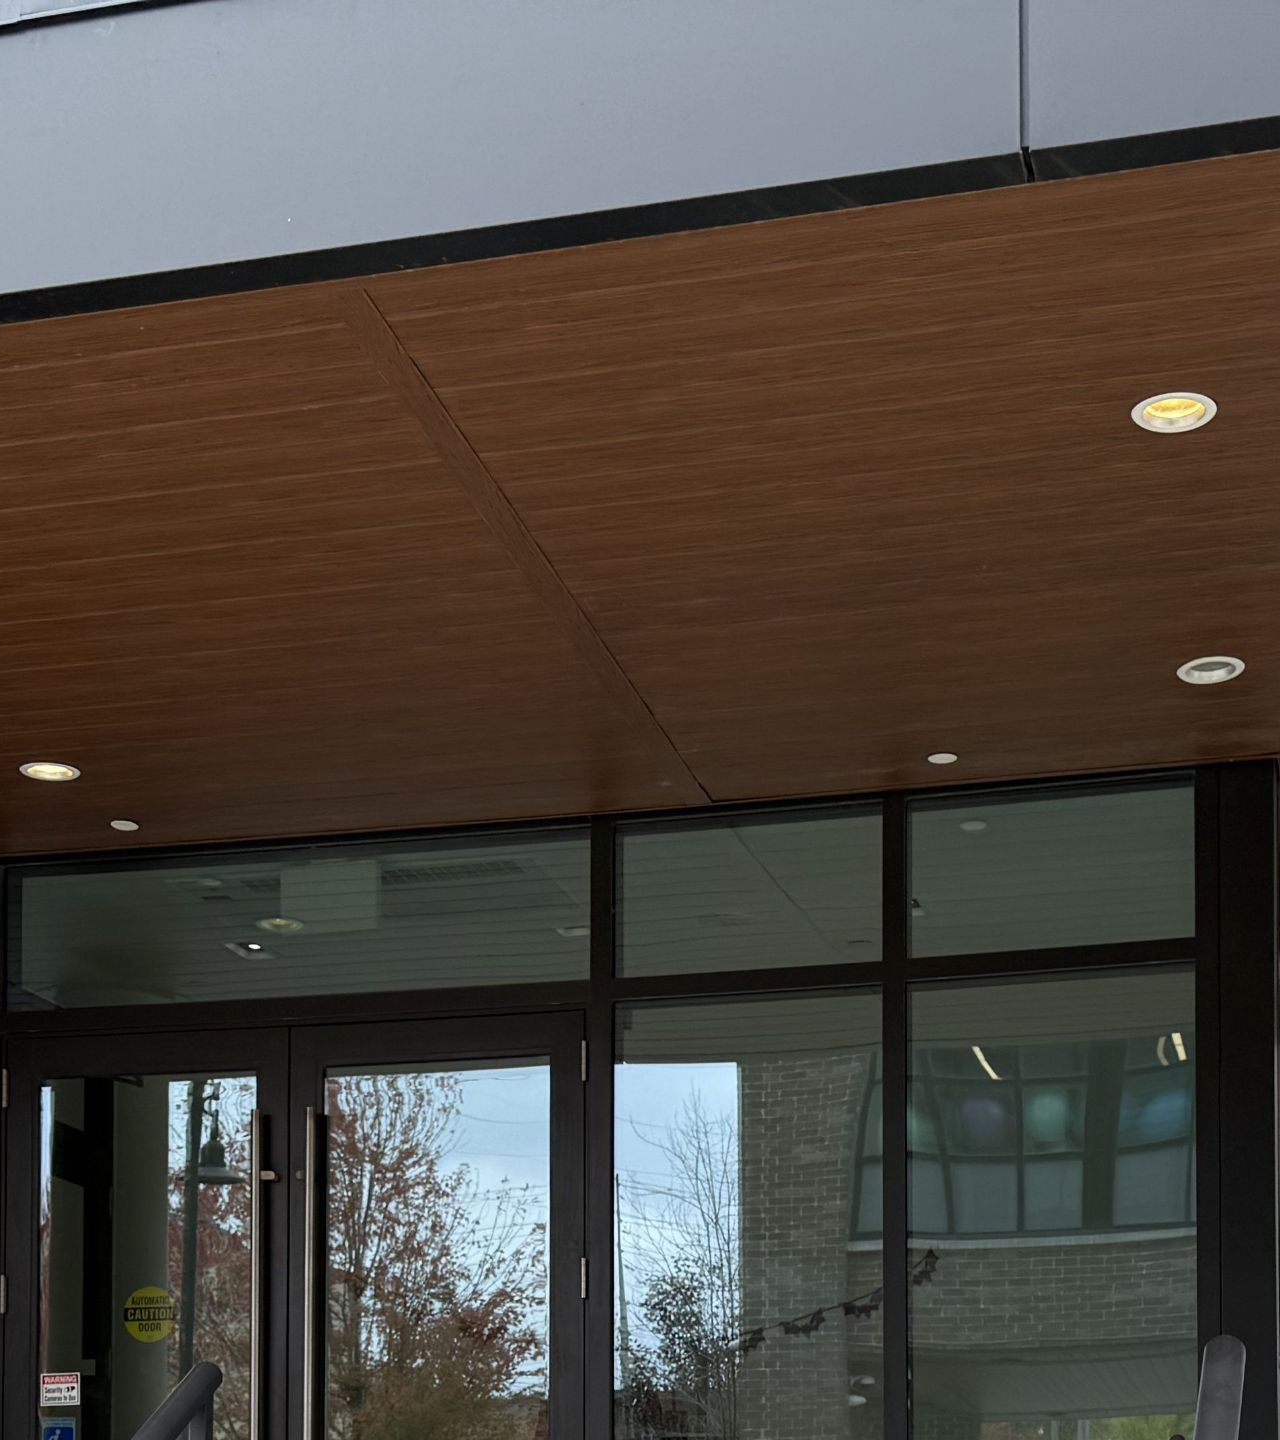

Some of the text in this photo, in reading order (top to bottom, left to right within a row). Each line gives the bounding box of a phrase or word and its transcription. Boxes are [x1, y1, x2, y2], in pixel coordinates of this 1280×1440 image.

[127, 1308, 174, 1320] CAUTION
[138, 1322, 162, 1332] DOOR
[44, 1375, 77, 1384] WARNING
